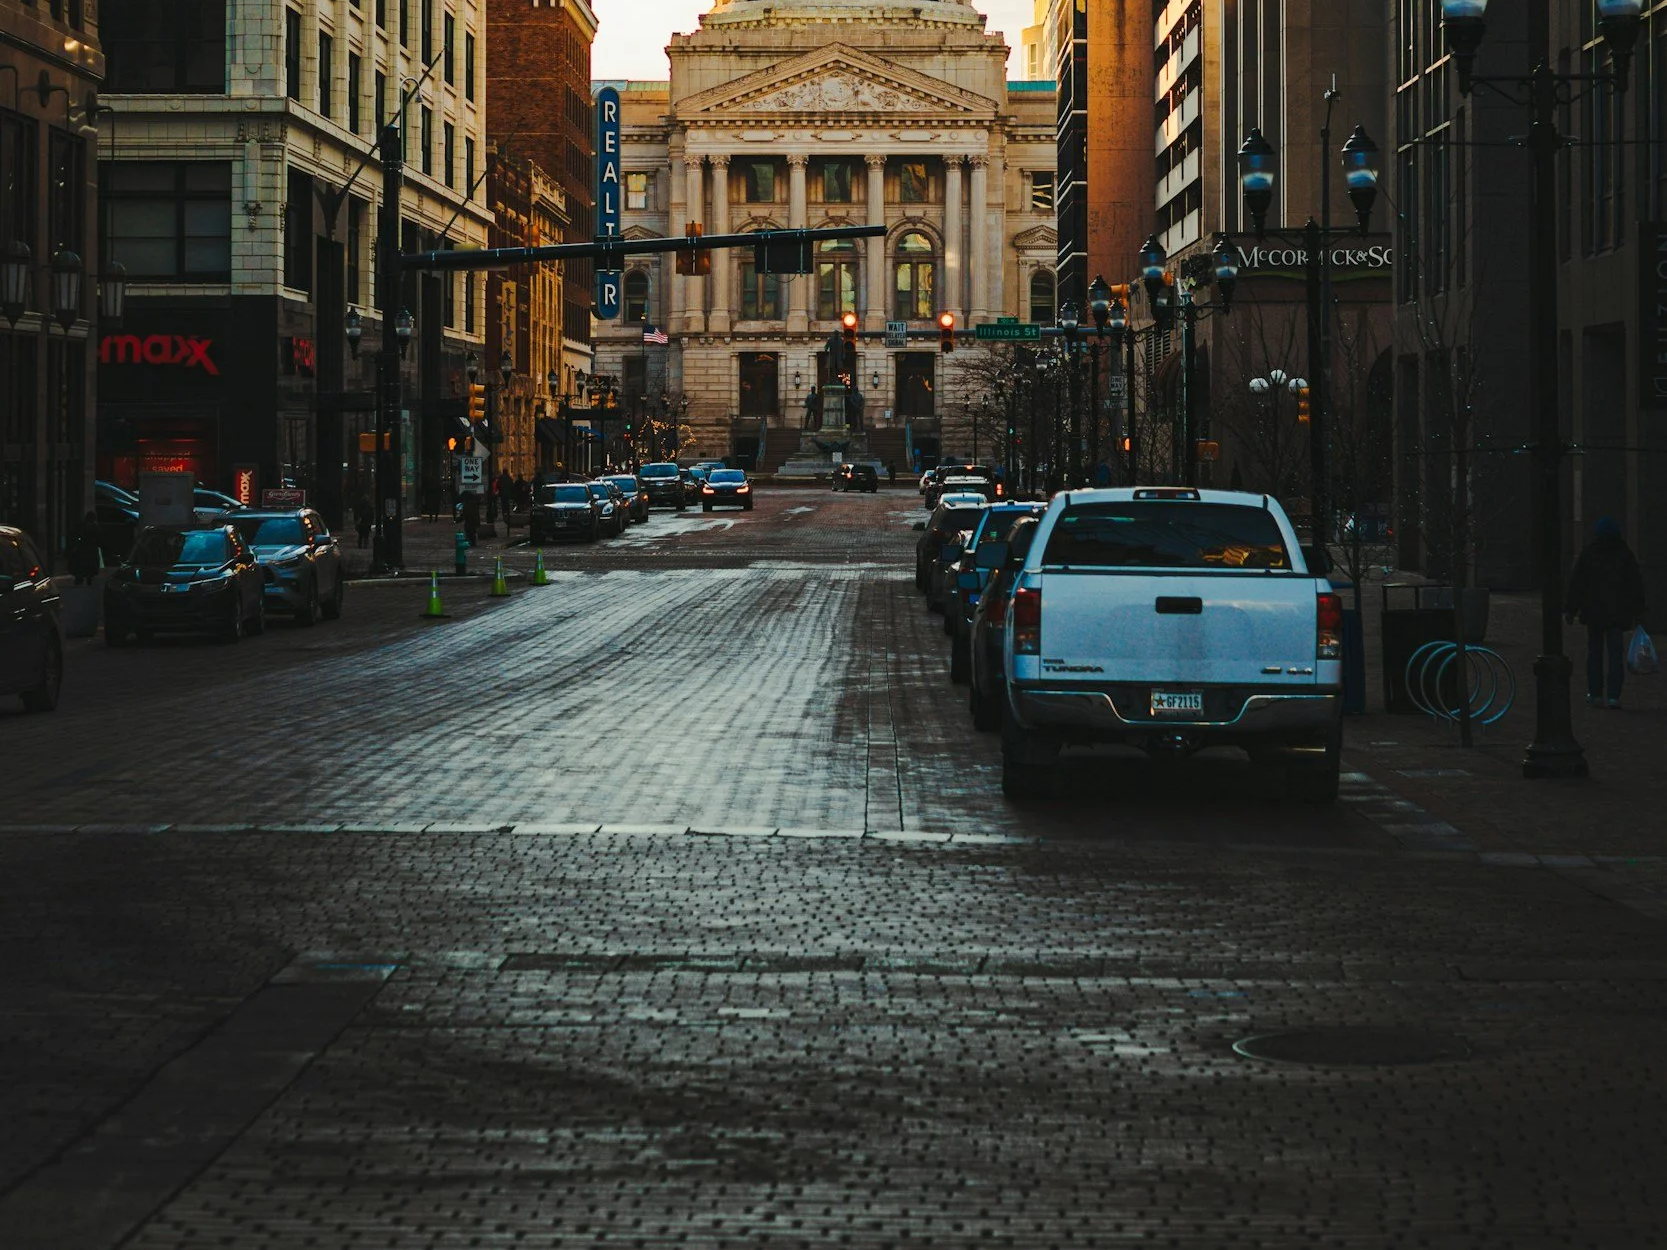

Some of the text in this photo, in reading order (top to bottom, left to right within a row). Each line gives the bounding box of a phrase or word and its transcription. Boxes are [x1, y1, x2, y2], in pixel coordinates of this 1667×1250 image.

[603, 100, 618, 306] REALTR
[888, 323, 904, 332] WAIT
[979, 327, 1037, 337] Illinois St
